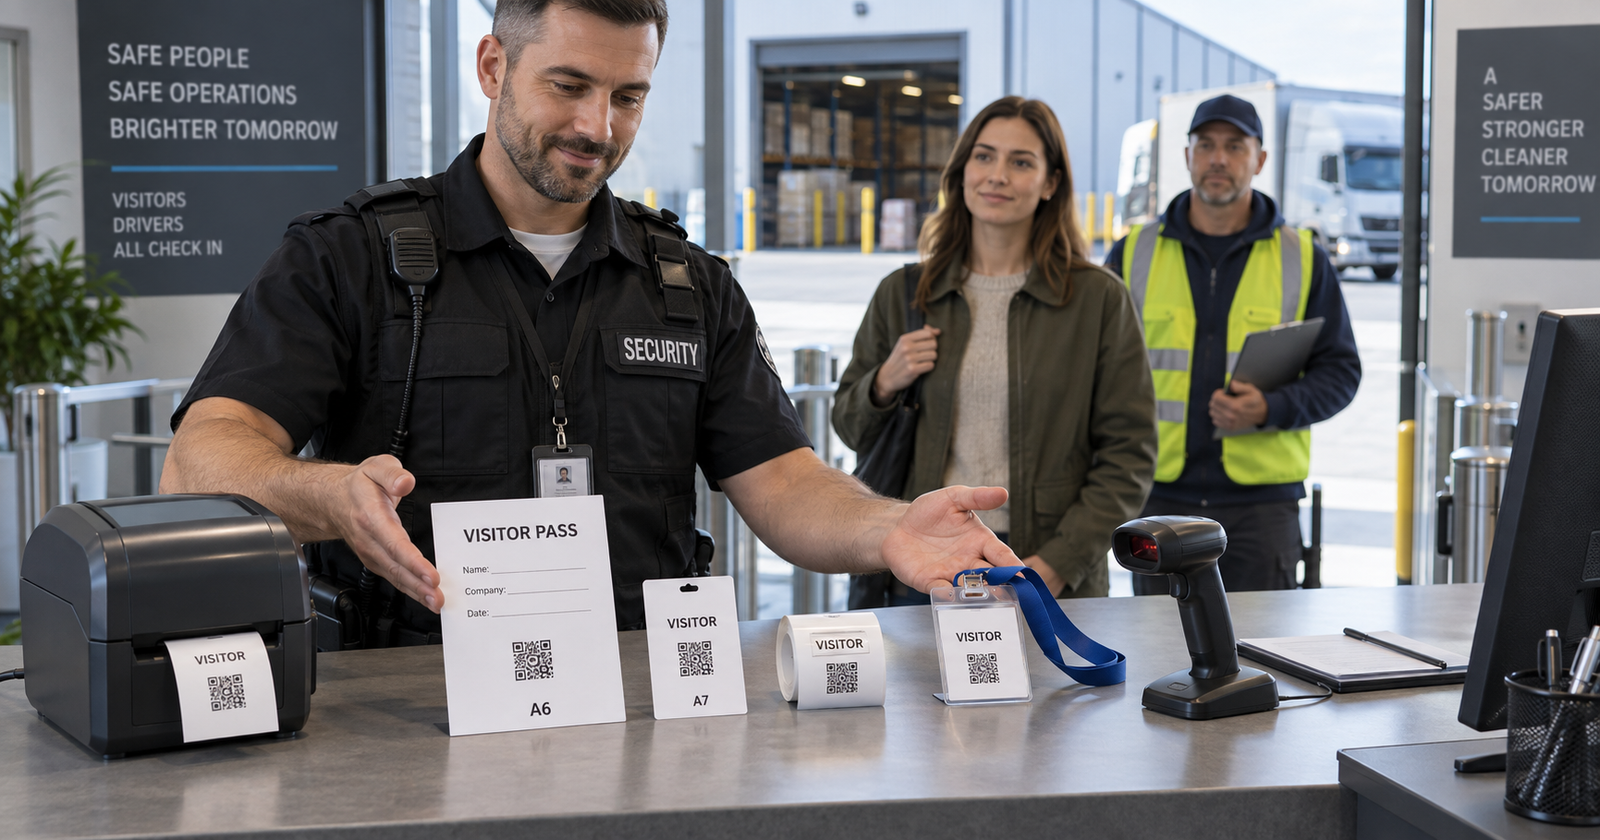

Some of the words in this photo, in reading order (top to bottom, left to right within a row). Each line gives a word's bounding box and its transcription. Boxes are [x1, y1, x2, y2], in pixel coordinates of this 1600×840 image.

[107, 42, 163, 66] SAFE
[170, 45, 250, 69] PEOPLE
[1483, 66, 1498, 85] A
[108, 80, 163, 103] SAFE
[170, 82, 297, 105] OPERATIONS
[1483, 92, 1543, 111] SAFER
[110, 117, 218, 140] BRIGHTER
[223, 119, 338, 142] TOMORROW
[1482, 119, 1585, 139] STRONGER
[1482, 147, 1568, 166] CLEANER
[1481, 175, 1597, 194] TOMORROW
[112, 191, 187, 209] VISITORS
[113, 215, 184, 233] DRIVERS
[113, 241, 145, 258] ALL
[148, 240, 202, 257] CHECK
[206, 240, 223, 256] IN
[623, 336, 698, 366] SECURITY
[463, 524, 531, 542] VISITOR
[535, 522, 578, 540] PASS
[462, 566, 490, 574] Name:
[465, 587, 506, 596] Company:
[467, 609, 490, 618] Date:
[666, 615, 718, 629] VISITOR
[815, 638, 864, 650] VISITOR
[955, 630, 1003, 643] VISITOR
[194, 650, 246, 665] VISITOR
[529, 701, 552, 717] A6
[693, 694, 709, 707] A7
